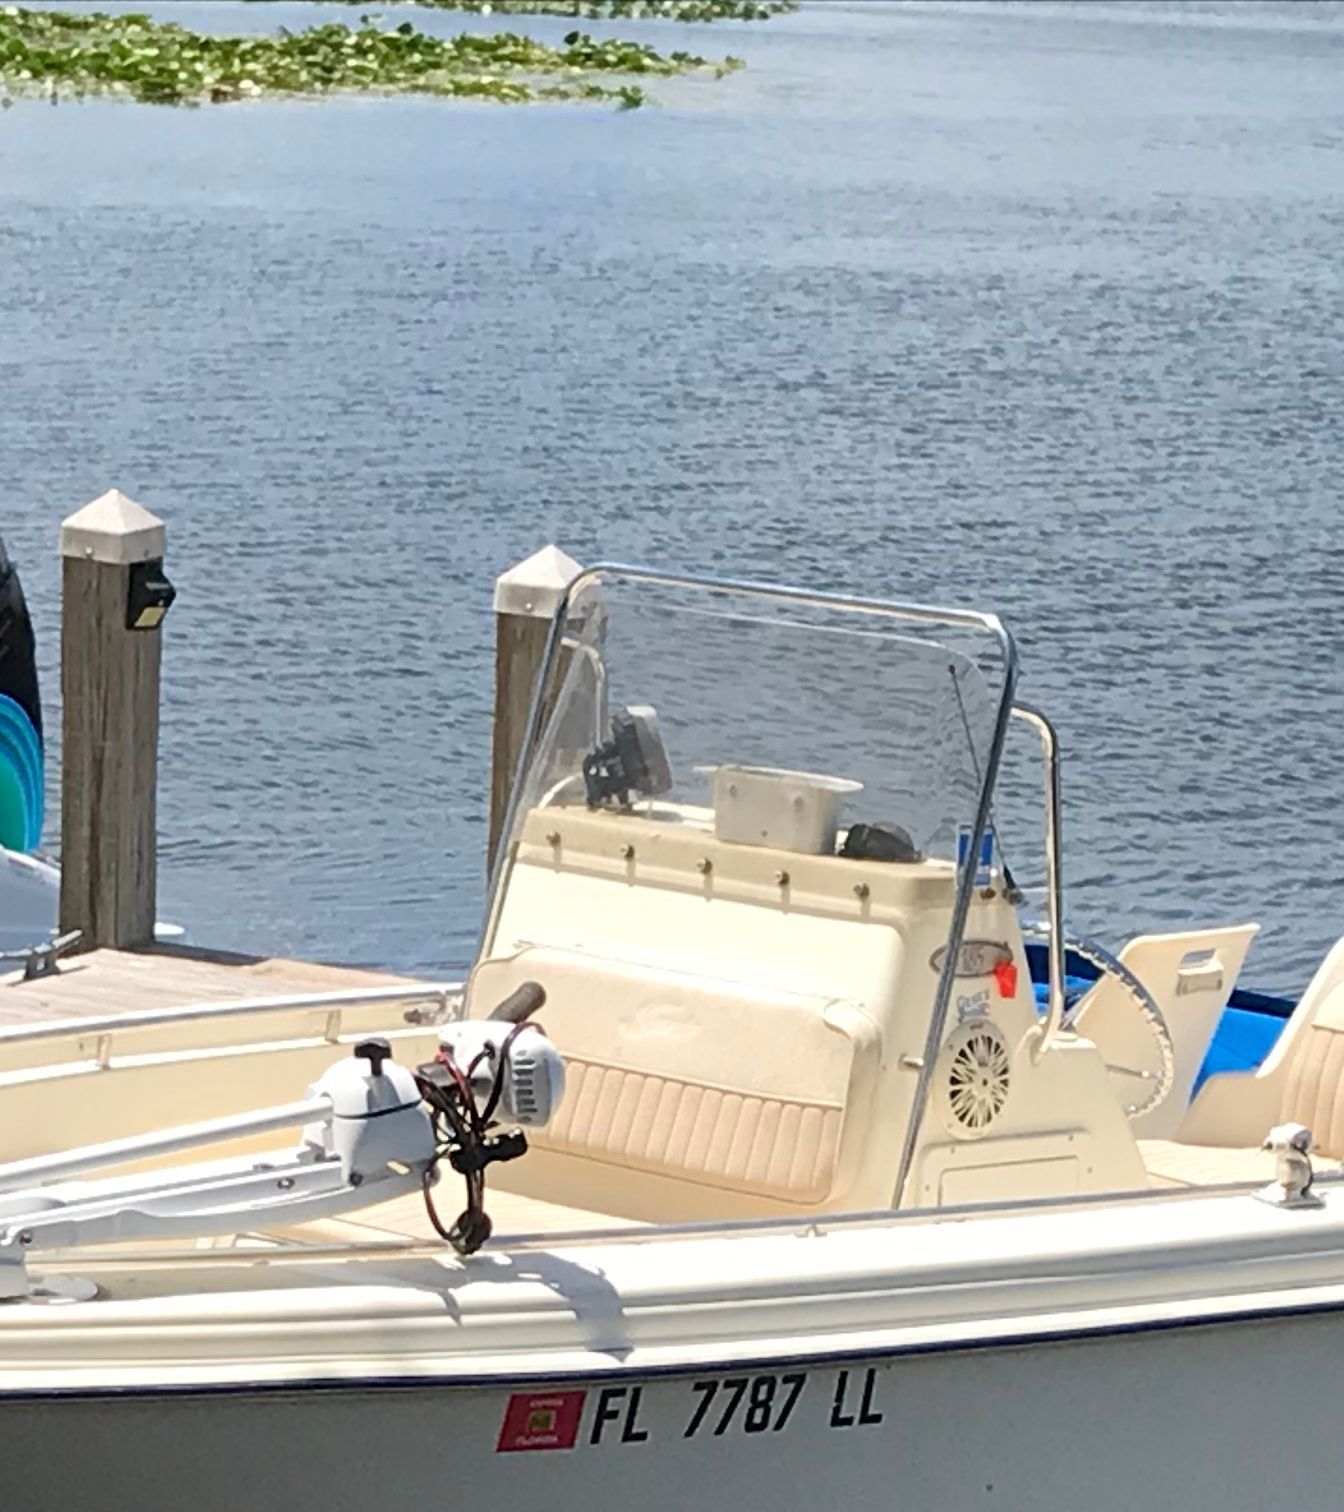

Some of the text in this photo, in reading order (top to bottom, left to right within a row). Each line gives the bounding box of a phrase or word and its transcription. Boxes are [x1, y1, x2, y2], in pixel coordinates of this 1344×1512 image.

[590, 1368, 884, 1445] FL 7787 LL
